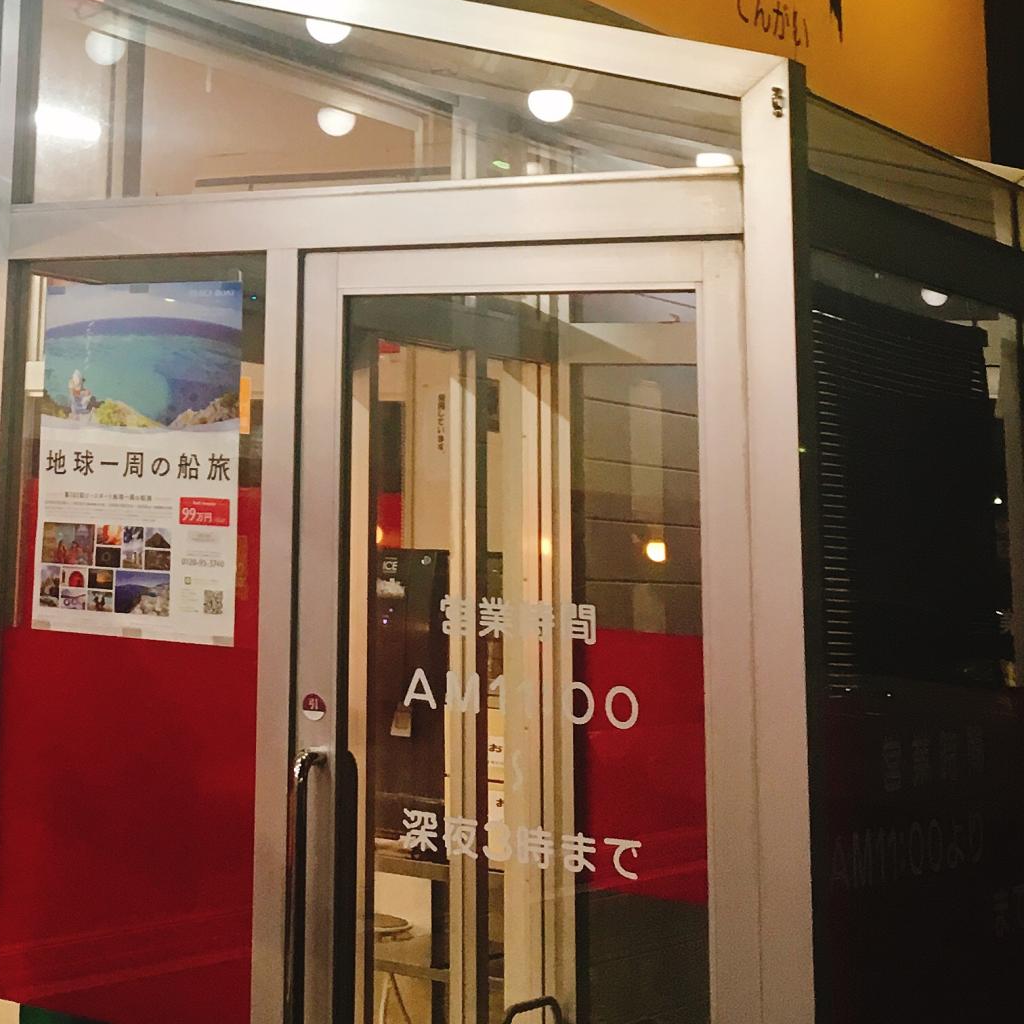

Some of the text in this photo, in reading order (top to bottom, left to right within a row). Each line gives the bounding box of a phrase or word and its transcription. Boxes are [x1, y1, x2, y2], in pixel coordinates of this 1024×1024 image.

[45, 449, 231, 481] 地球一周の船旅
[182, 507, 212, 523] 99万円
[440, 594, 597, 645] 営業時間
[402, 808, 642, 880] 深夜3時まで
